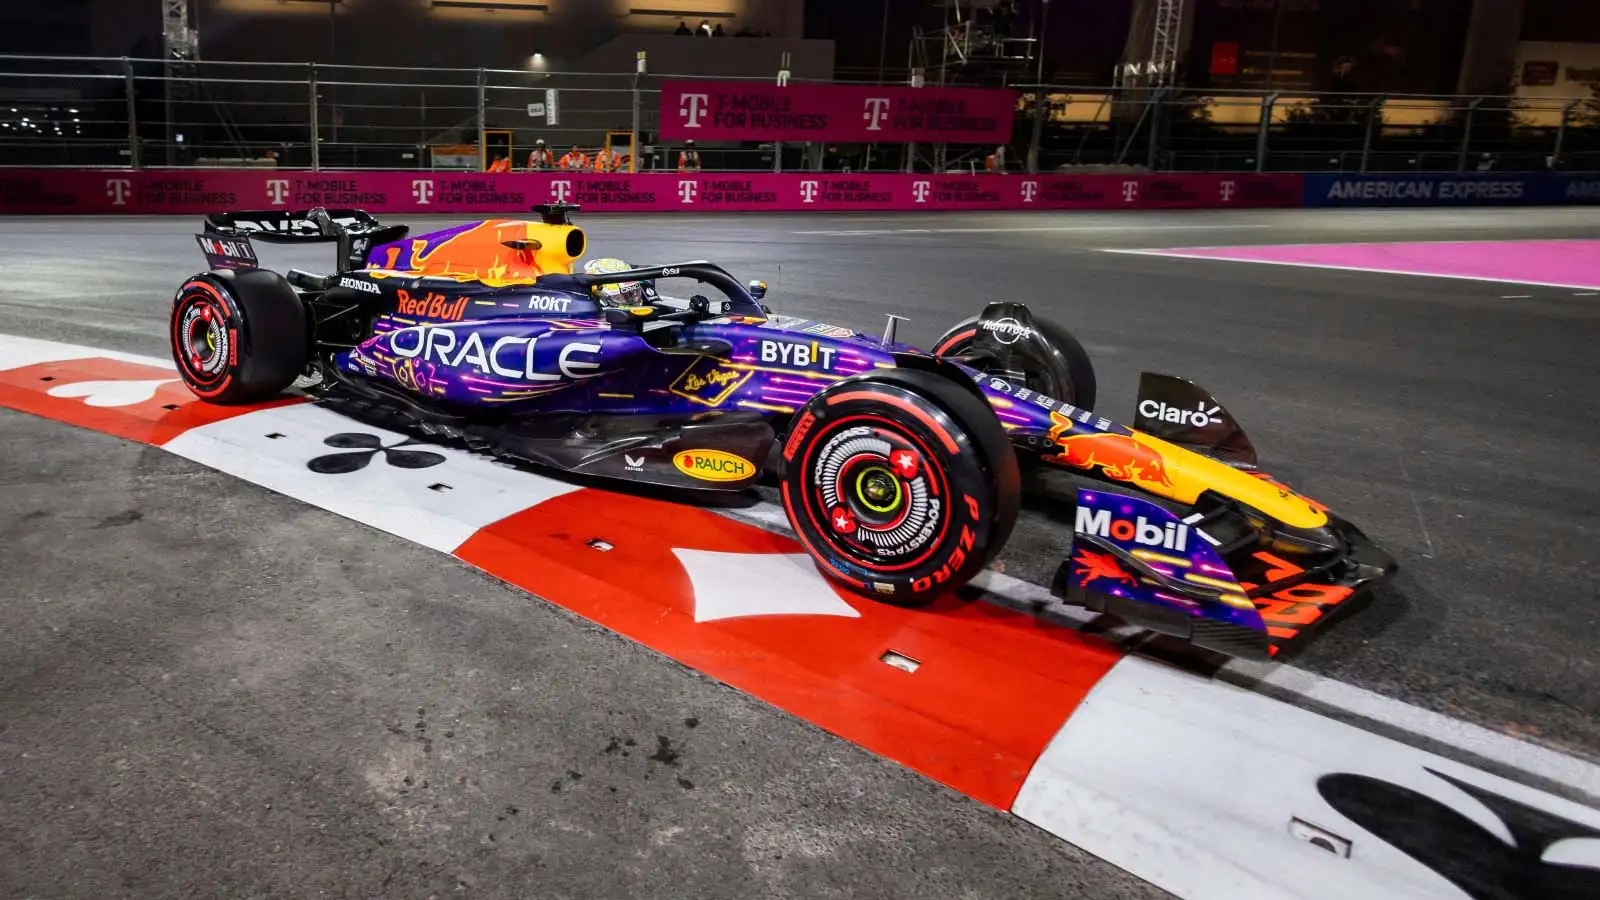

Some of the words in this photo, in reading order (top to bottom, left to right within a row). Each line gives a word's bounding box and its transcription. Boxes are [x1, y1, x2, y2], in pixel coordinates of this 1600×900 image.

[713, 113, 747, 129] FOR
[752, 114, 828, 131] BUSINESS
[295, 193, 320, 205] FOR
[325, 193, 388, 205] BUSINESS
[439, 193, 462, 204] FOR
[467, 193, 525, 205] BUSINESS
[576, 192, 597, 203] FOR
[602, 192, 657, 204] BUSINESS
[1327, 182, 1433, 198] AMERICAN
[1438, 182, 1523, 198] EXPRESS
[200, 237, 241, 258] Mobil
[340, 277, 382, 294] HONDA
[528, 295, 572, 313] ROKT
[390, 326, 601, 381] ORACLE
[761, 340, 836, 370] BYBIT
[684, 374, 706, 391] Las
[706, 369, 739, 386] Vegas
[1139, 400, 1208, 427] Claro
[696, 456, 744, 475] RAUCH
[963, 494, 979, 521] P
[876, 498, 940, 556] POKERSTARS
[1074, 506, 1189, 551] Mobil
[912, 525, 976, 593] ZERO
